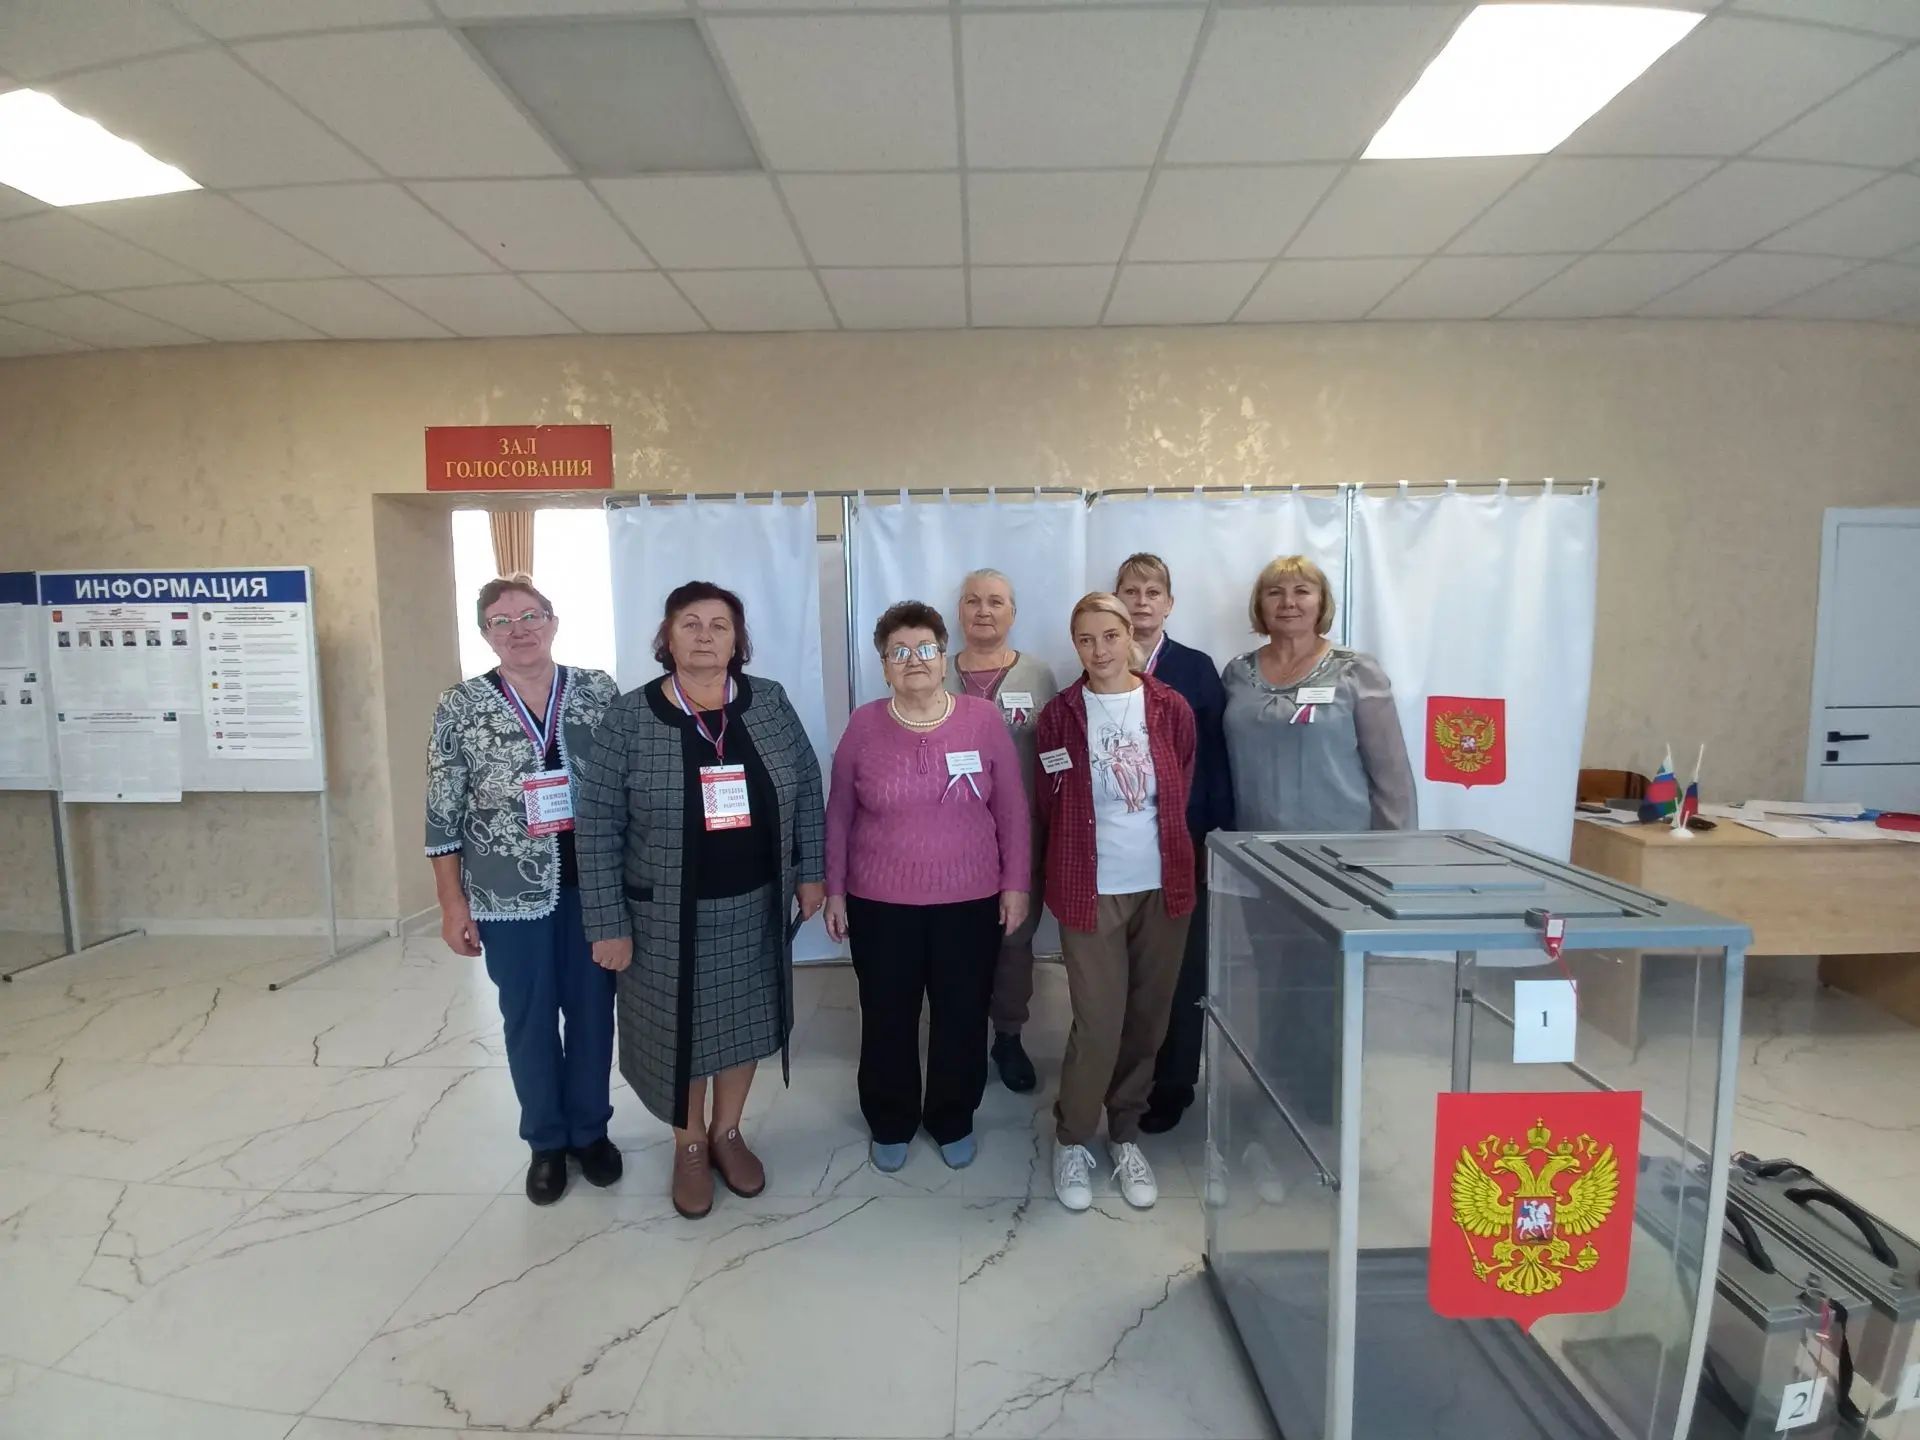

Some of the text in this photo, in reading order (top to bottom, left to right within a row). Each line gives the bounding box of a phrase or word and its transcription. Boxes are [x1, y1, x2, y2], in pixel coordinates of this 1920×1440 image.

[499, 437, 537, 456] ЗАЛ
[445, 459, 592, 478] ГОЛОСОВАНИЯ
[75, 577, 268, 601] ИНФОРМАЦИЯ
[1541, 1010, 1549, 1028] 1
[1788, 1391, 1808, 1420] 2
